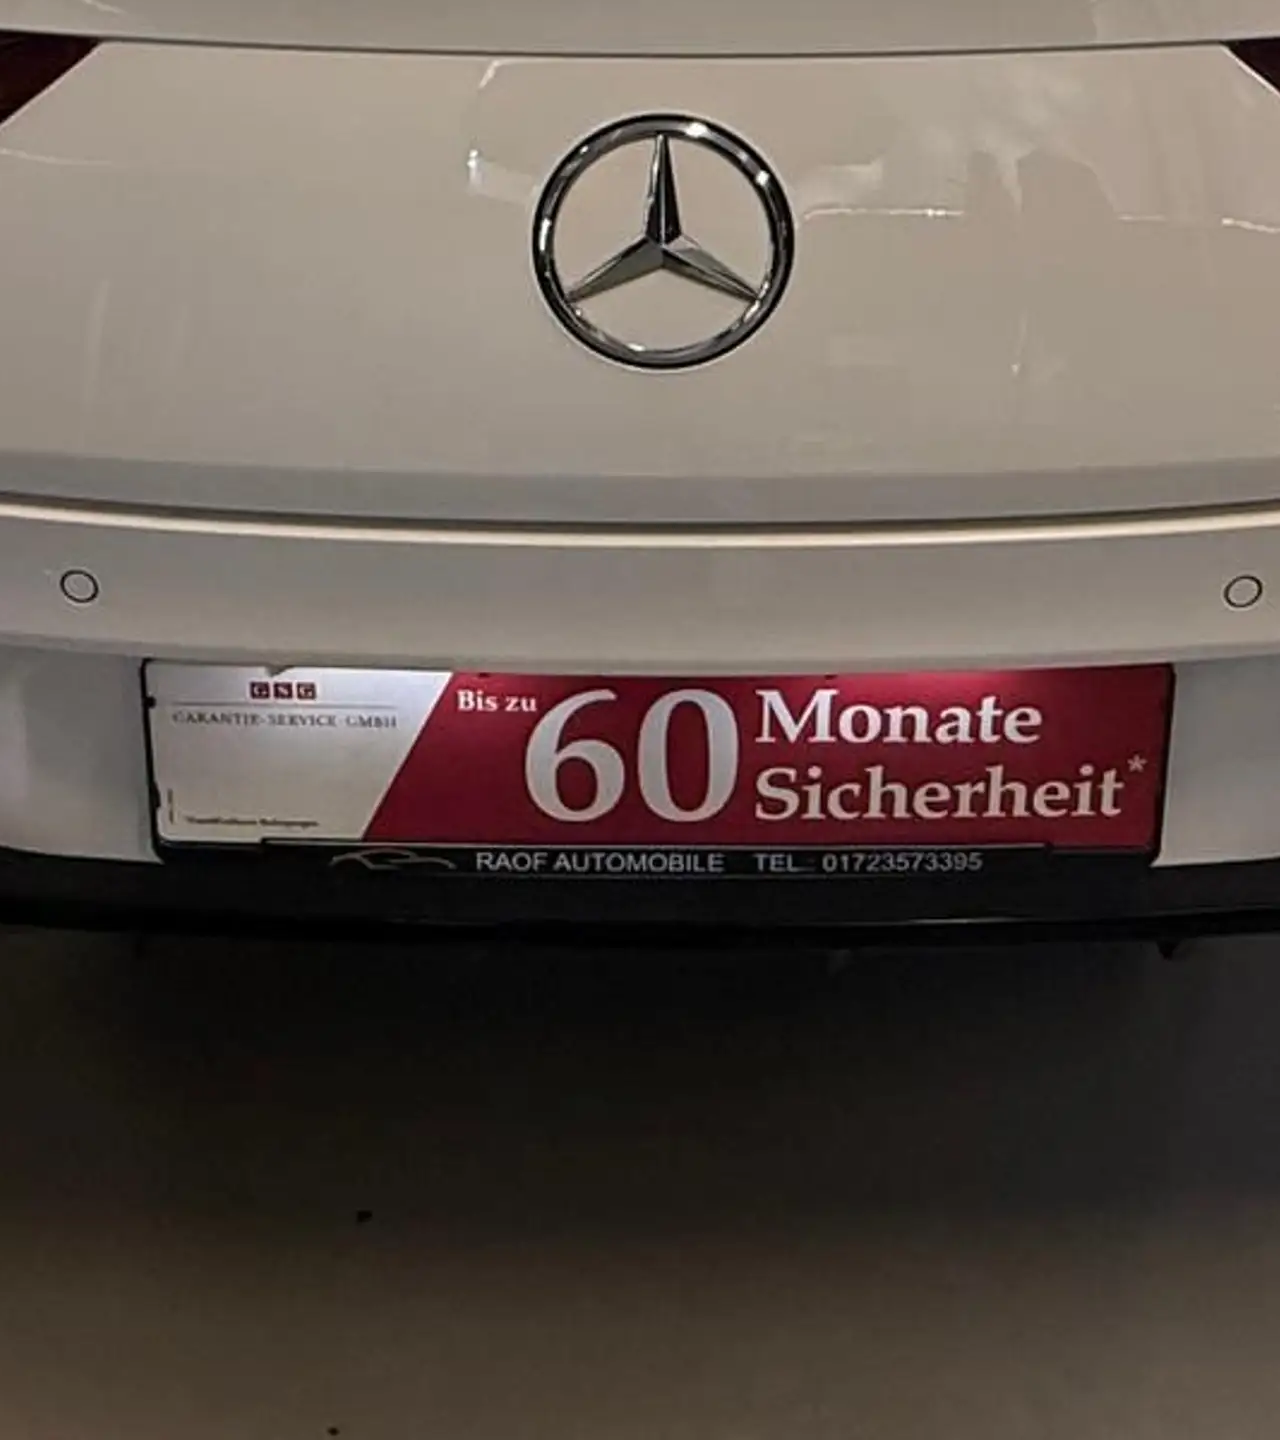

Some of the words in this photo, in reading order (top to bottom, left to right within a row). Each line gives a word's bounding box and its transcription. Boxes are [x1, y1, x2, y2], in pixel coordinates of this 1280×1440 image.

[755, 688, 1043, 744] Monate
[457, 689, 497, 712] Bis
[505, 695, 537, 712] zu
[525, 688, 739, 822] 60
[476, 852, 549, 872] RAOF
[553, 852, 727, 873] AUTOMOBILE
[821, 852, 983, 873] 01723573395
